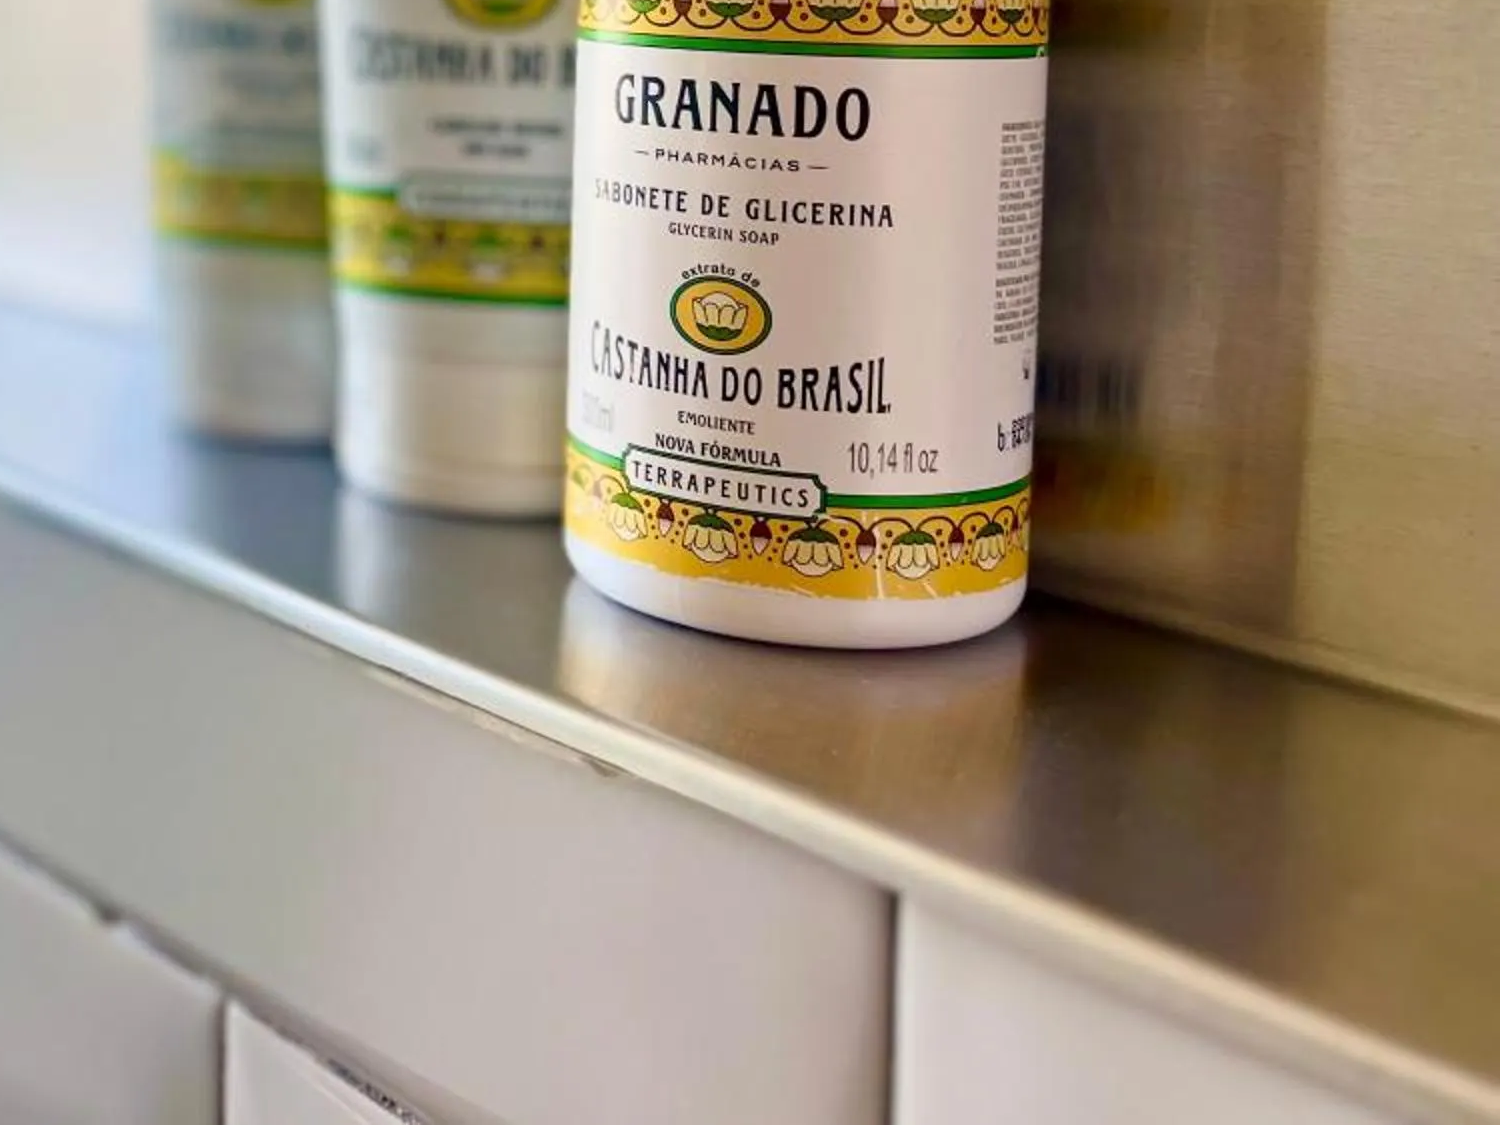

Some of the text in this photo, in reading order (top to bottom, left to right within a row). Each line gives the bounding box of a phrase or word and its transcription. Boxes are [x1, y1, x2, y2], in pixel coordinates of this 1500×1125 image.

[615, 73, 871, 142] GRANADO
[655, 148, 800, 173] PHARMÁCIAS
[595, 178, 688, 213] SABONETE
[700, 193, 731, 218] DE
[745, 198, 893, 228] GLICERINA
[668, 222, 779, 245] GLYCERIN SOAP
[681, 263, 761, 287] extrato de
[591, 320, 708, 399] CASTANHA
[721, 366, 762, 406] DO
[677, 410, 756, 435] EMOLIENTE
[655, 433, 781, 467] NOVA FÓRMULA
[848, 442, 939, 478] 10,14 fl oz
[631, 459, 809, 508] TERRAPEUTICS
